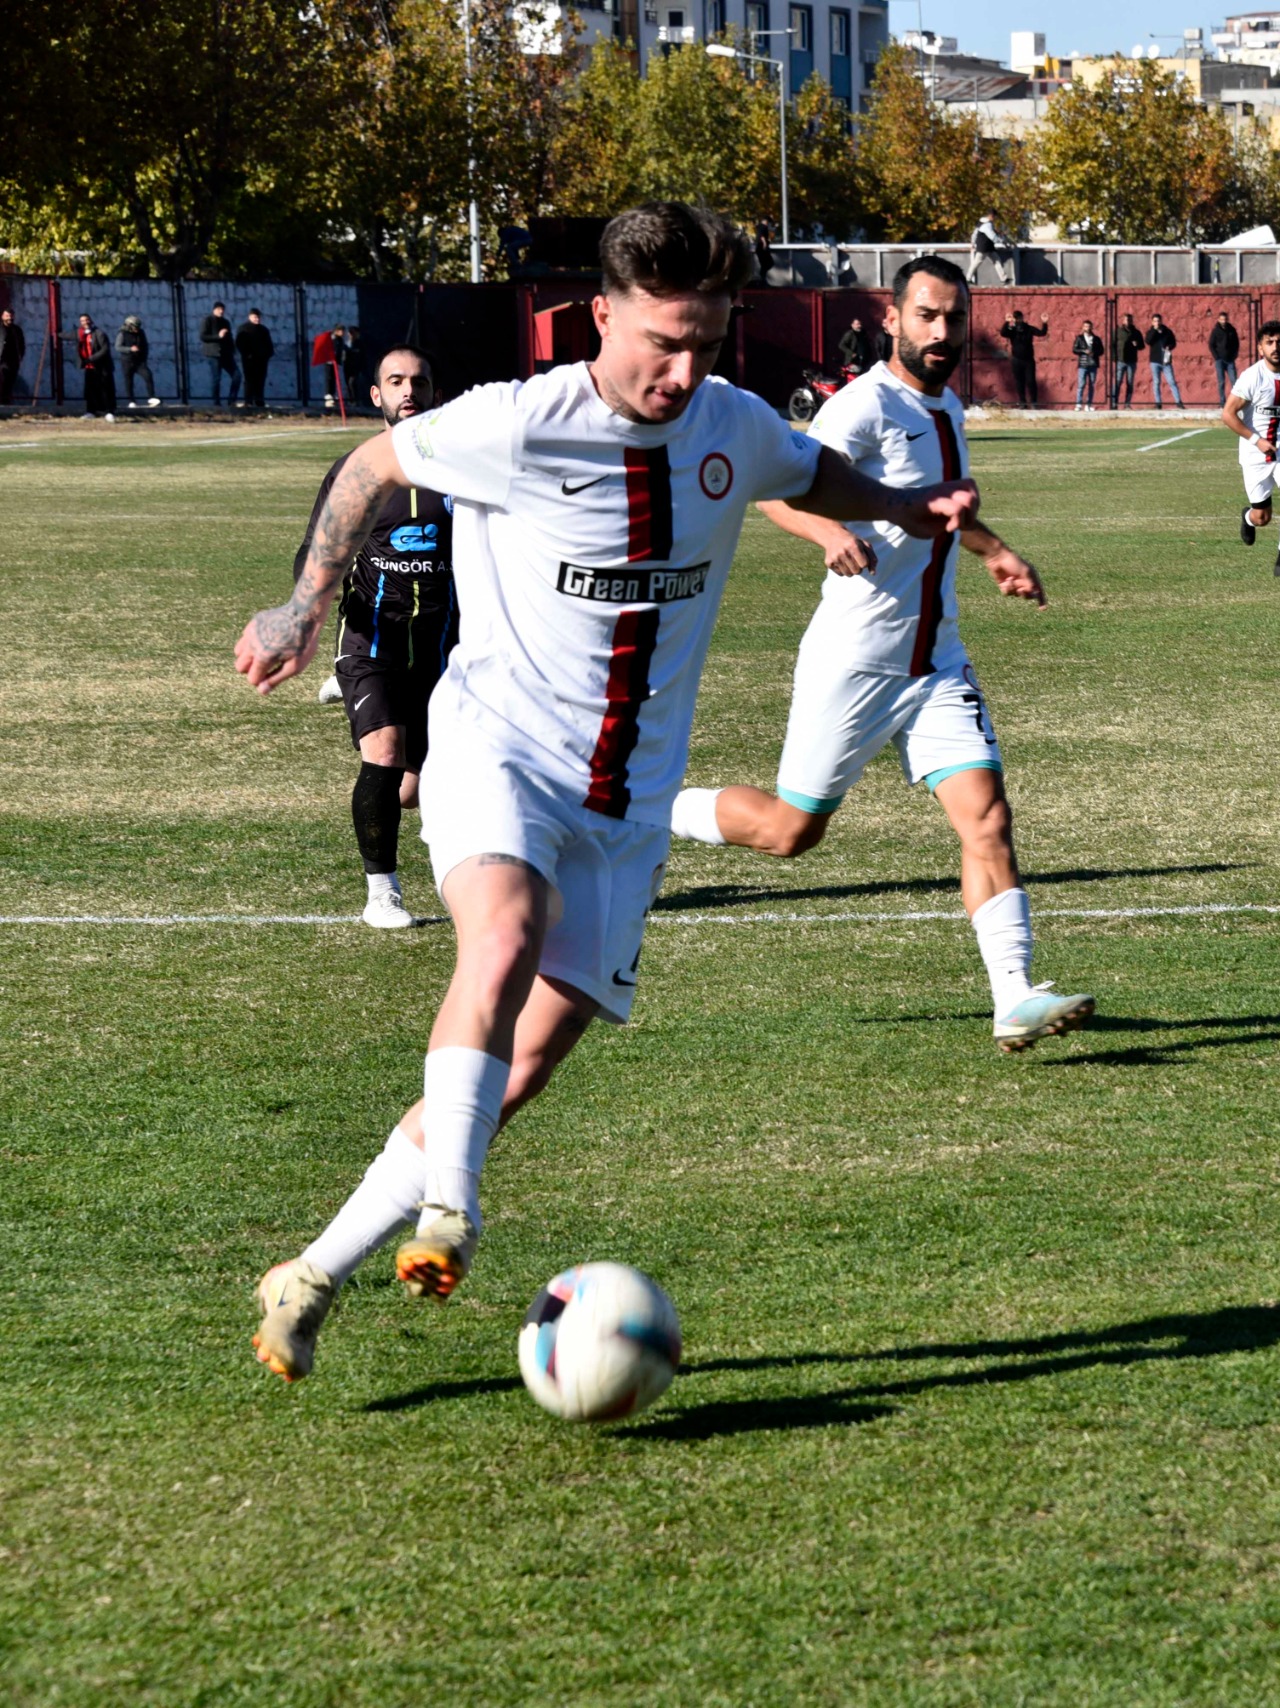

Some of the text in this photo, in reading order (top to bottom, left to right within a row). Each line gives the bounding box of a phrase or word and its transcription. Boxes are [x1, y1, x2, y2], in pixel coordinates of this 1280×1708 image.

[370, 557, 433, 573] GÜNGÖR
[563, 565, 707, 601] Green Power
